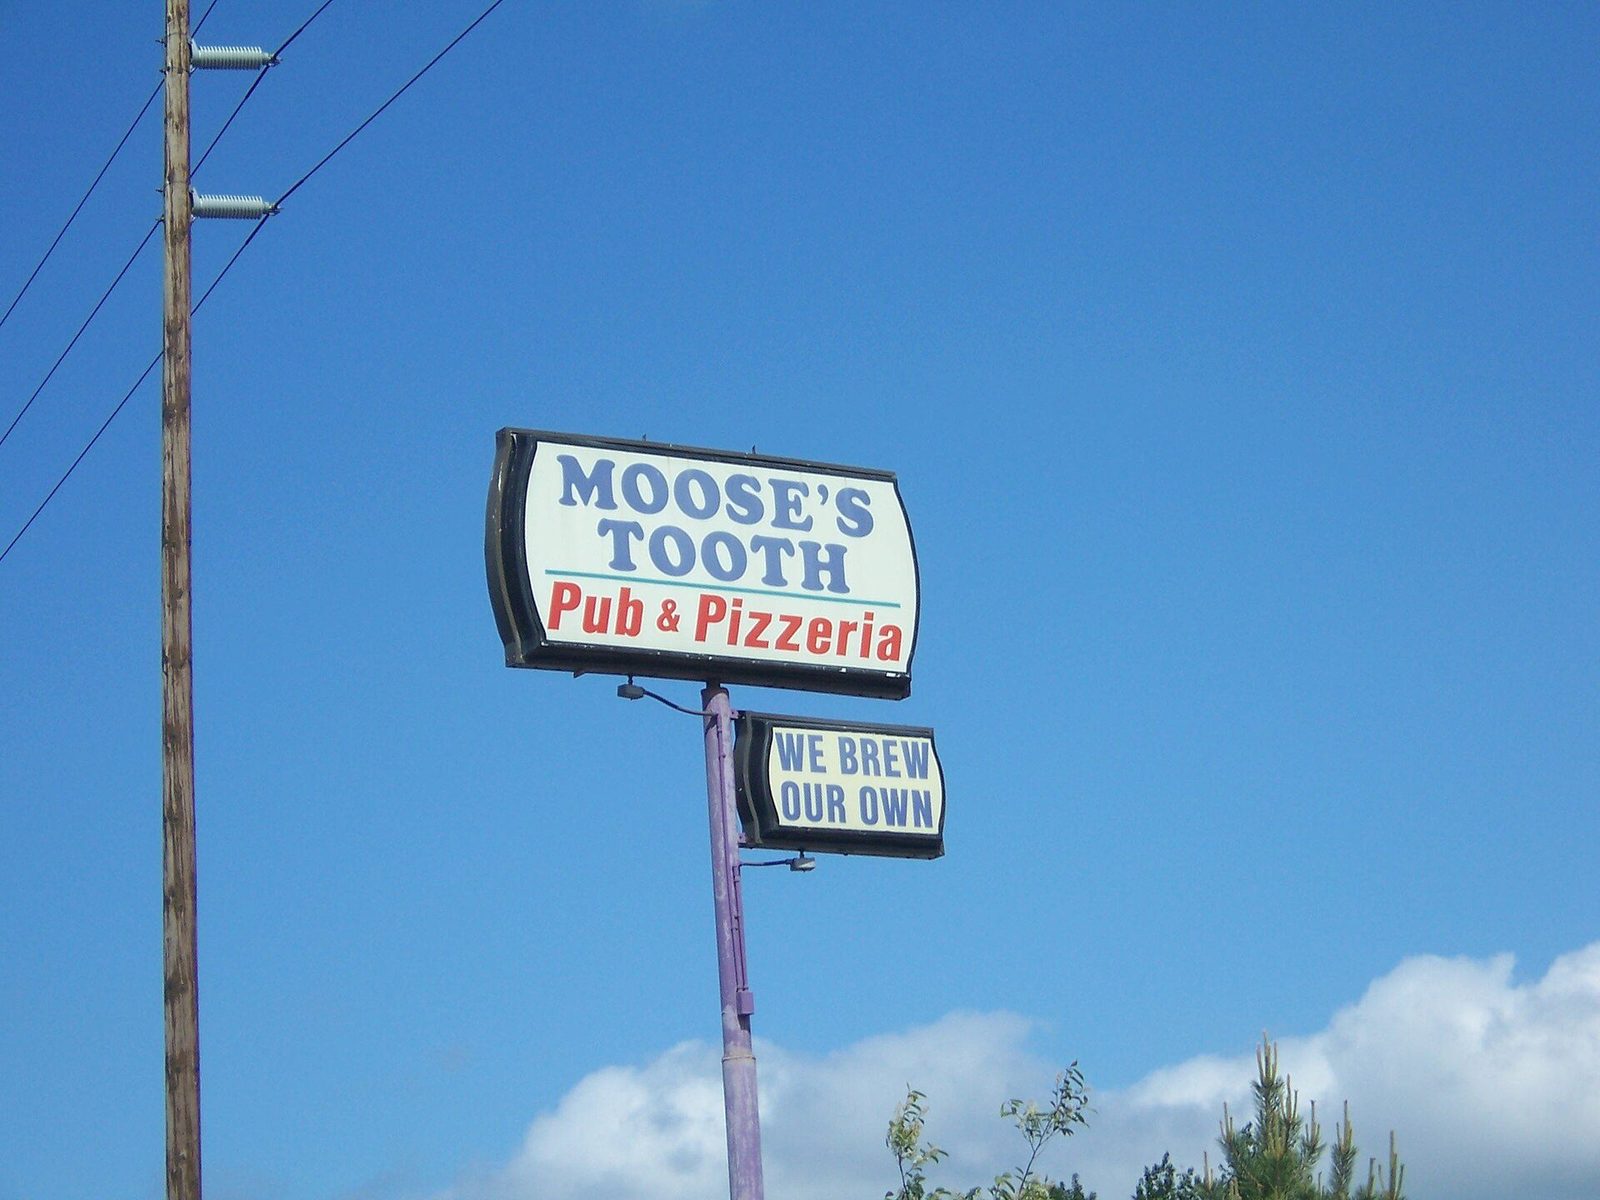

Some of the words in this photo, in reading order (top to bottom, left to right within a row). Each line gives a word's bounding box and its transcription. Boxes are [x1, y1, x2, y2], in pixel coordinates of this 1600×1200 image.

[557, 454, 874, 539] MOOSE'S
[597, 518, 851, 594] TOOTH
[547, 581, 645, 638] Pub
[656, 598, 681, 633] &
[694, 593, 903, 662] Pizzeria
[775, 732, 827, 773] WE
[838, 736, 929, 780] BREW
[780, 780, 846, 823] OUR
[859, 786, 934, 828] OWN
